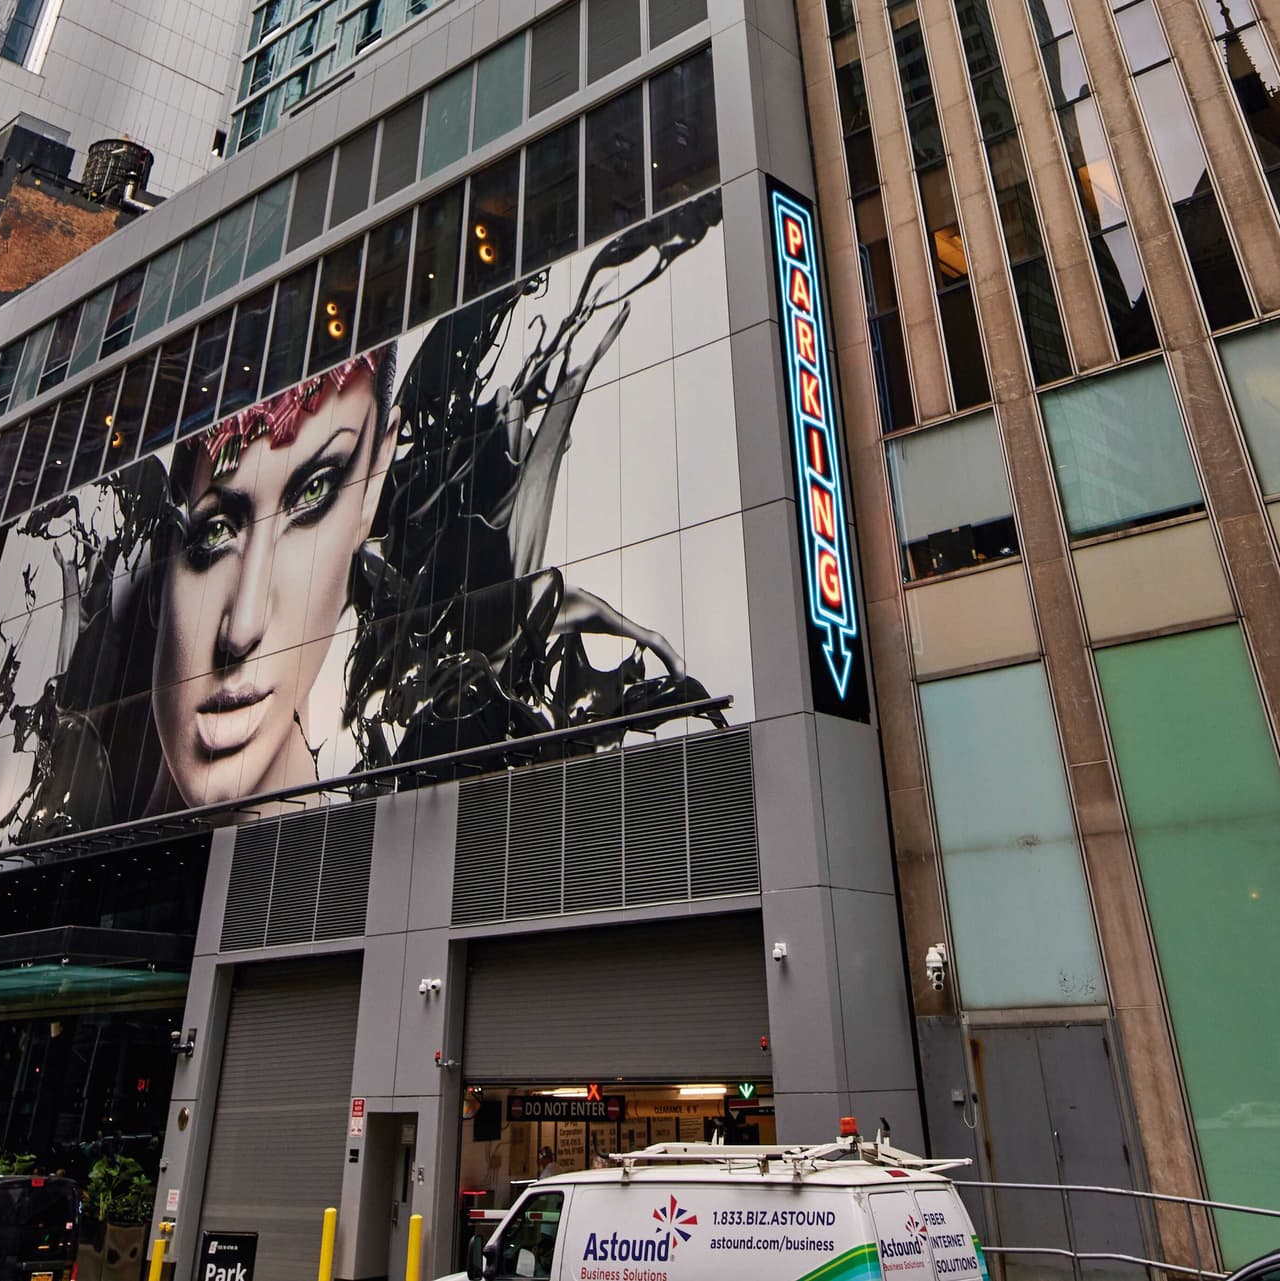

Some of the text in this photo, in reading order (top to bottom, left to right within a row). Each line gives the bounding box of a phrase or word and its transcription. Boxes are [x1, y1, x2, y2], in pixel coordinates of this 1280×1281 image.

[785, 218, 843, 607] PARKING
[525, 1100, 605, 1116] DO NOT ENTER
[712, 1211, 836, 1226] 1.833.BIZ.ASTOUND
[923, 1213, 946, 1225] FIBER
[583, 1232, 670, 1262] Astound
[710, 1234, 835, 1252] astound.com/business
[881, 1238, 921, 1258] Astound
[930, 1234, 966, 1248] INTERNET
[205, 1263, 247, 1281] Park
[883, 1263, 904, 1271] Business
[936, 1257, 978, 1273] SOLUTIONS
[581, 1267, 667, 1281] Business Solutions
